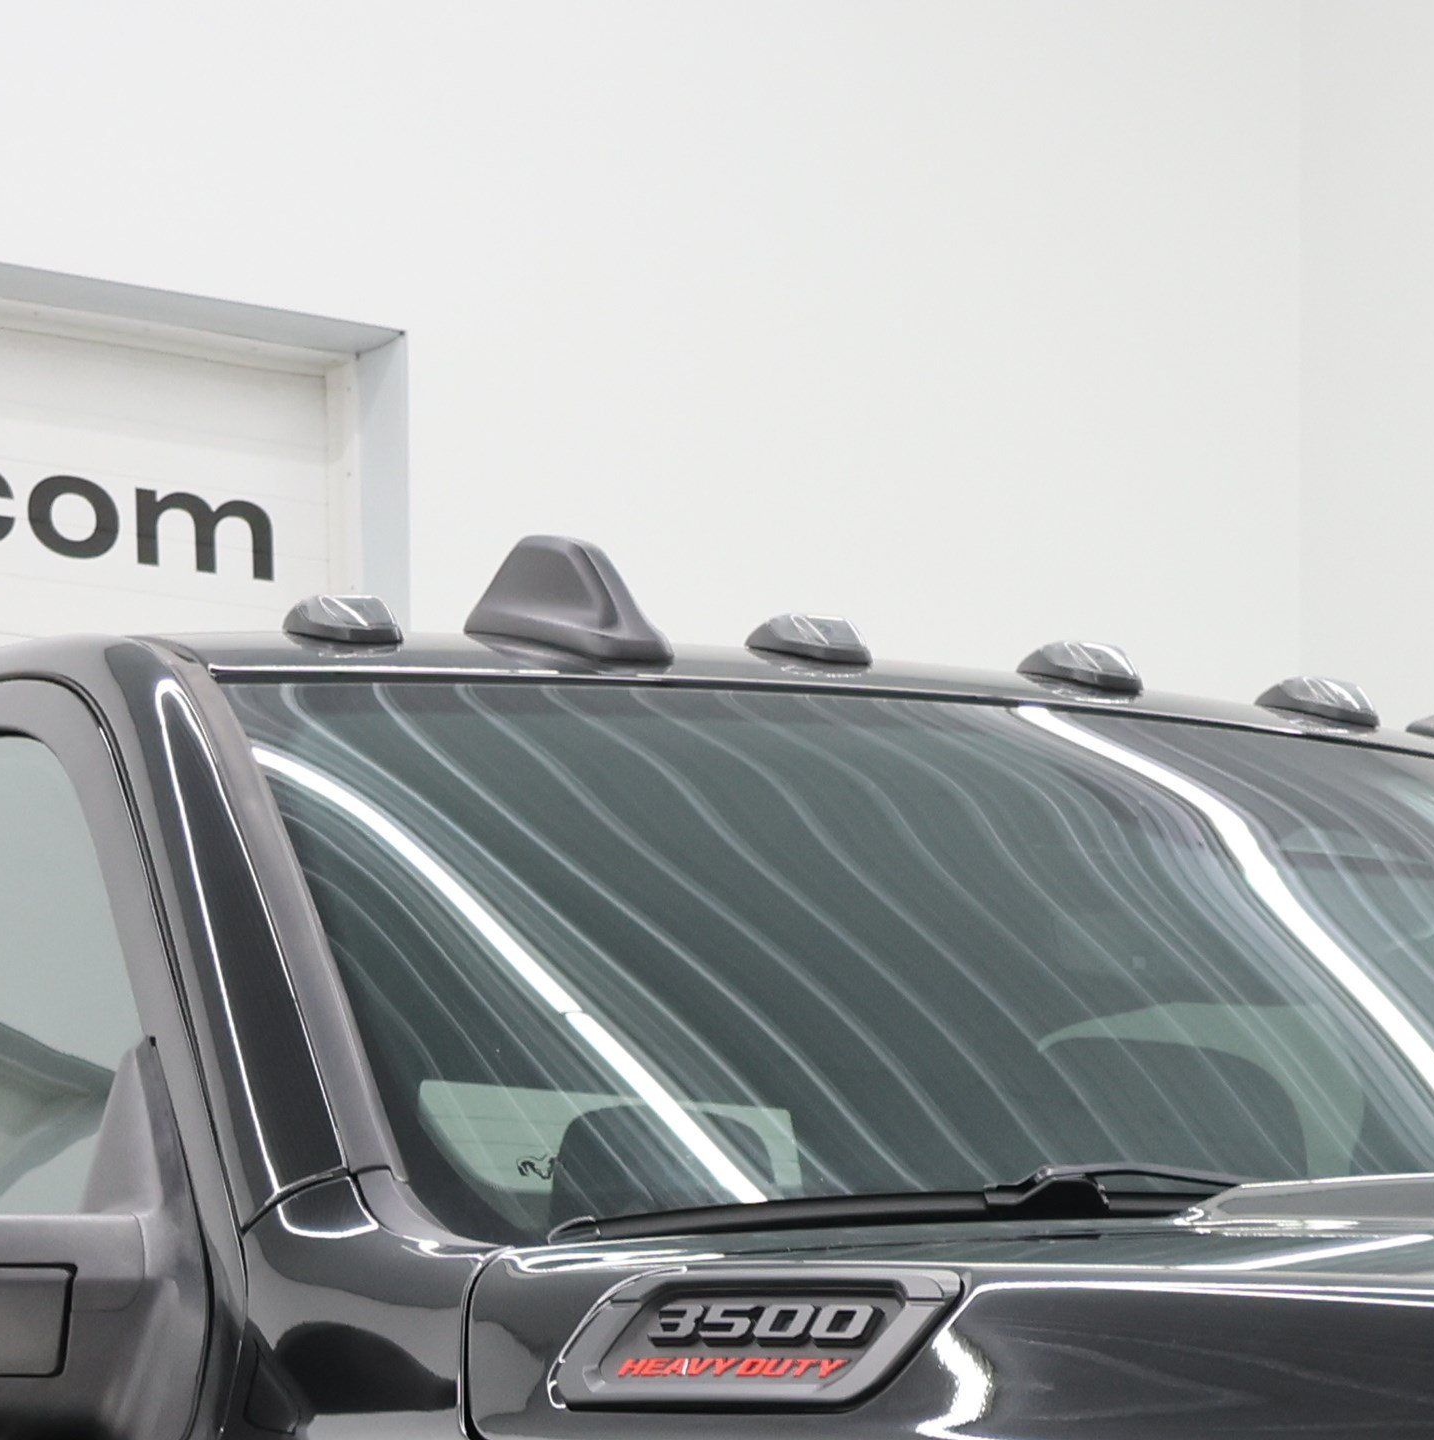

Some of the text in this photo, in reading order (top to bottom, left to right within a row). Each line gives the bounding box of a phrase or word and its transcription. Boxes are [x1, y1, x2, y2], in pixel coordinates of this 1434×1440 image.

[648, 1303, 880, 1346] 3500
[618, 1357, 847, 1378] HEAVY DUTY
